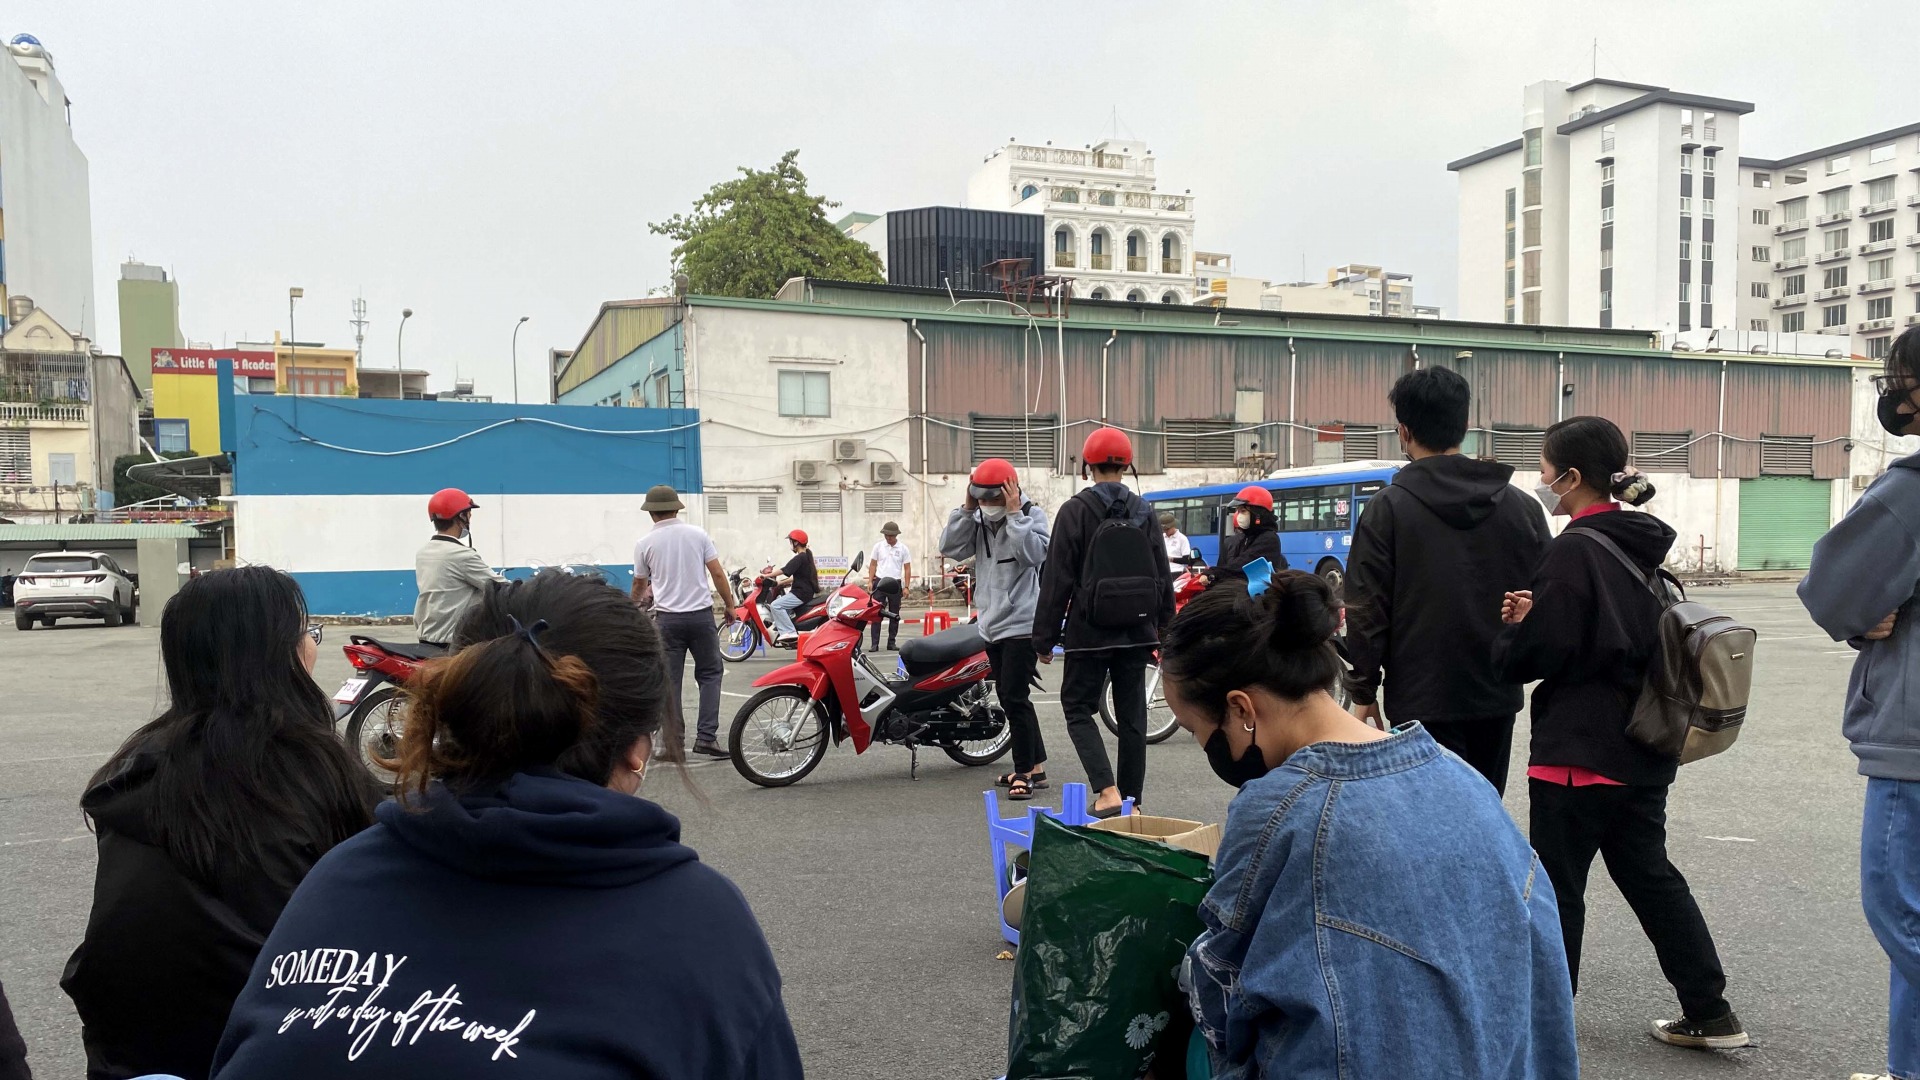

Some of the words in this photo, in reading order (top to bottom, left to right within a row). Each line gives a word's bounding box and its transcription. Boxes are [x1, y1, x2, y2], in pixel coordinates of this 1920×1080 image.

[180, 356, 204, 368] Little
[208, 357, 240, 369] Als
[1337, 502, 1346, 513] 93
[265, 948, 406, 989] SOMEDAY
[337, 1005, 351, 1019] a
[348, 985, 392, 1061] day
[392, 990, 432, 1047] of
[409, 984, 466, 1045] the
[462, 1009, 536, 1061] week
